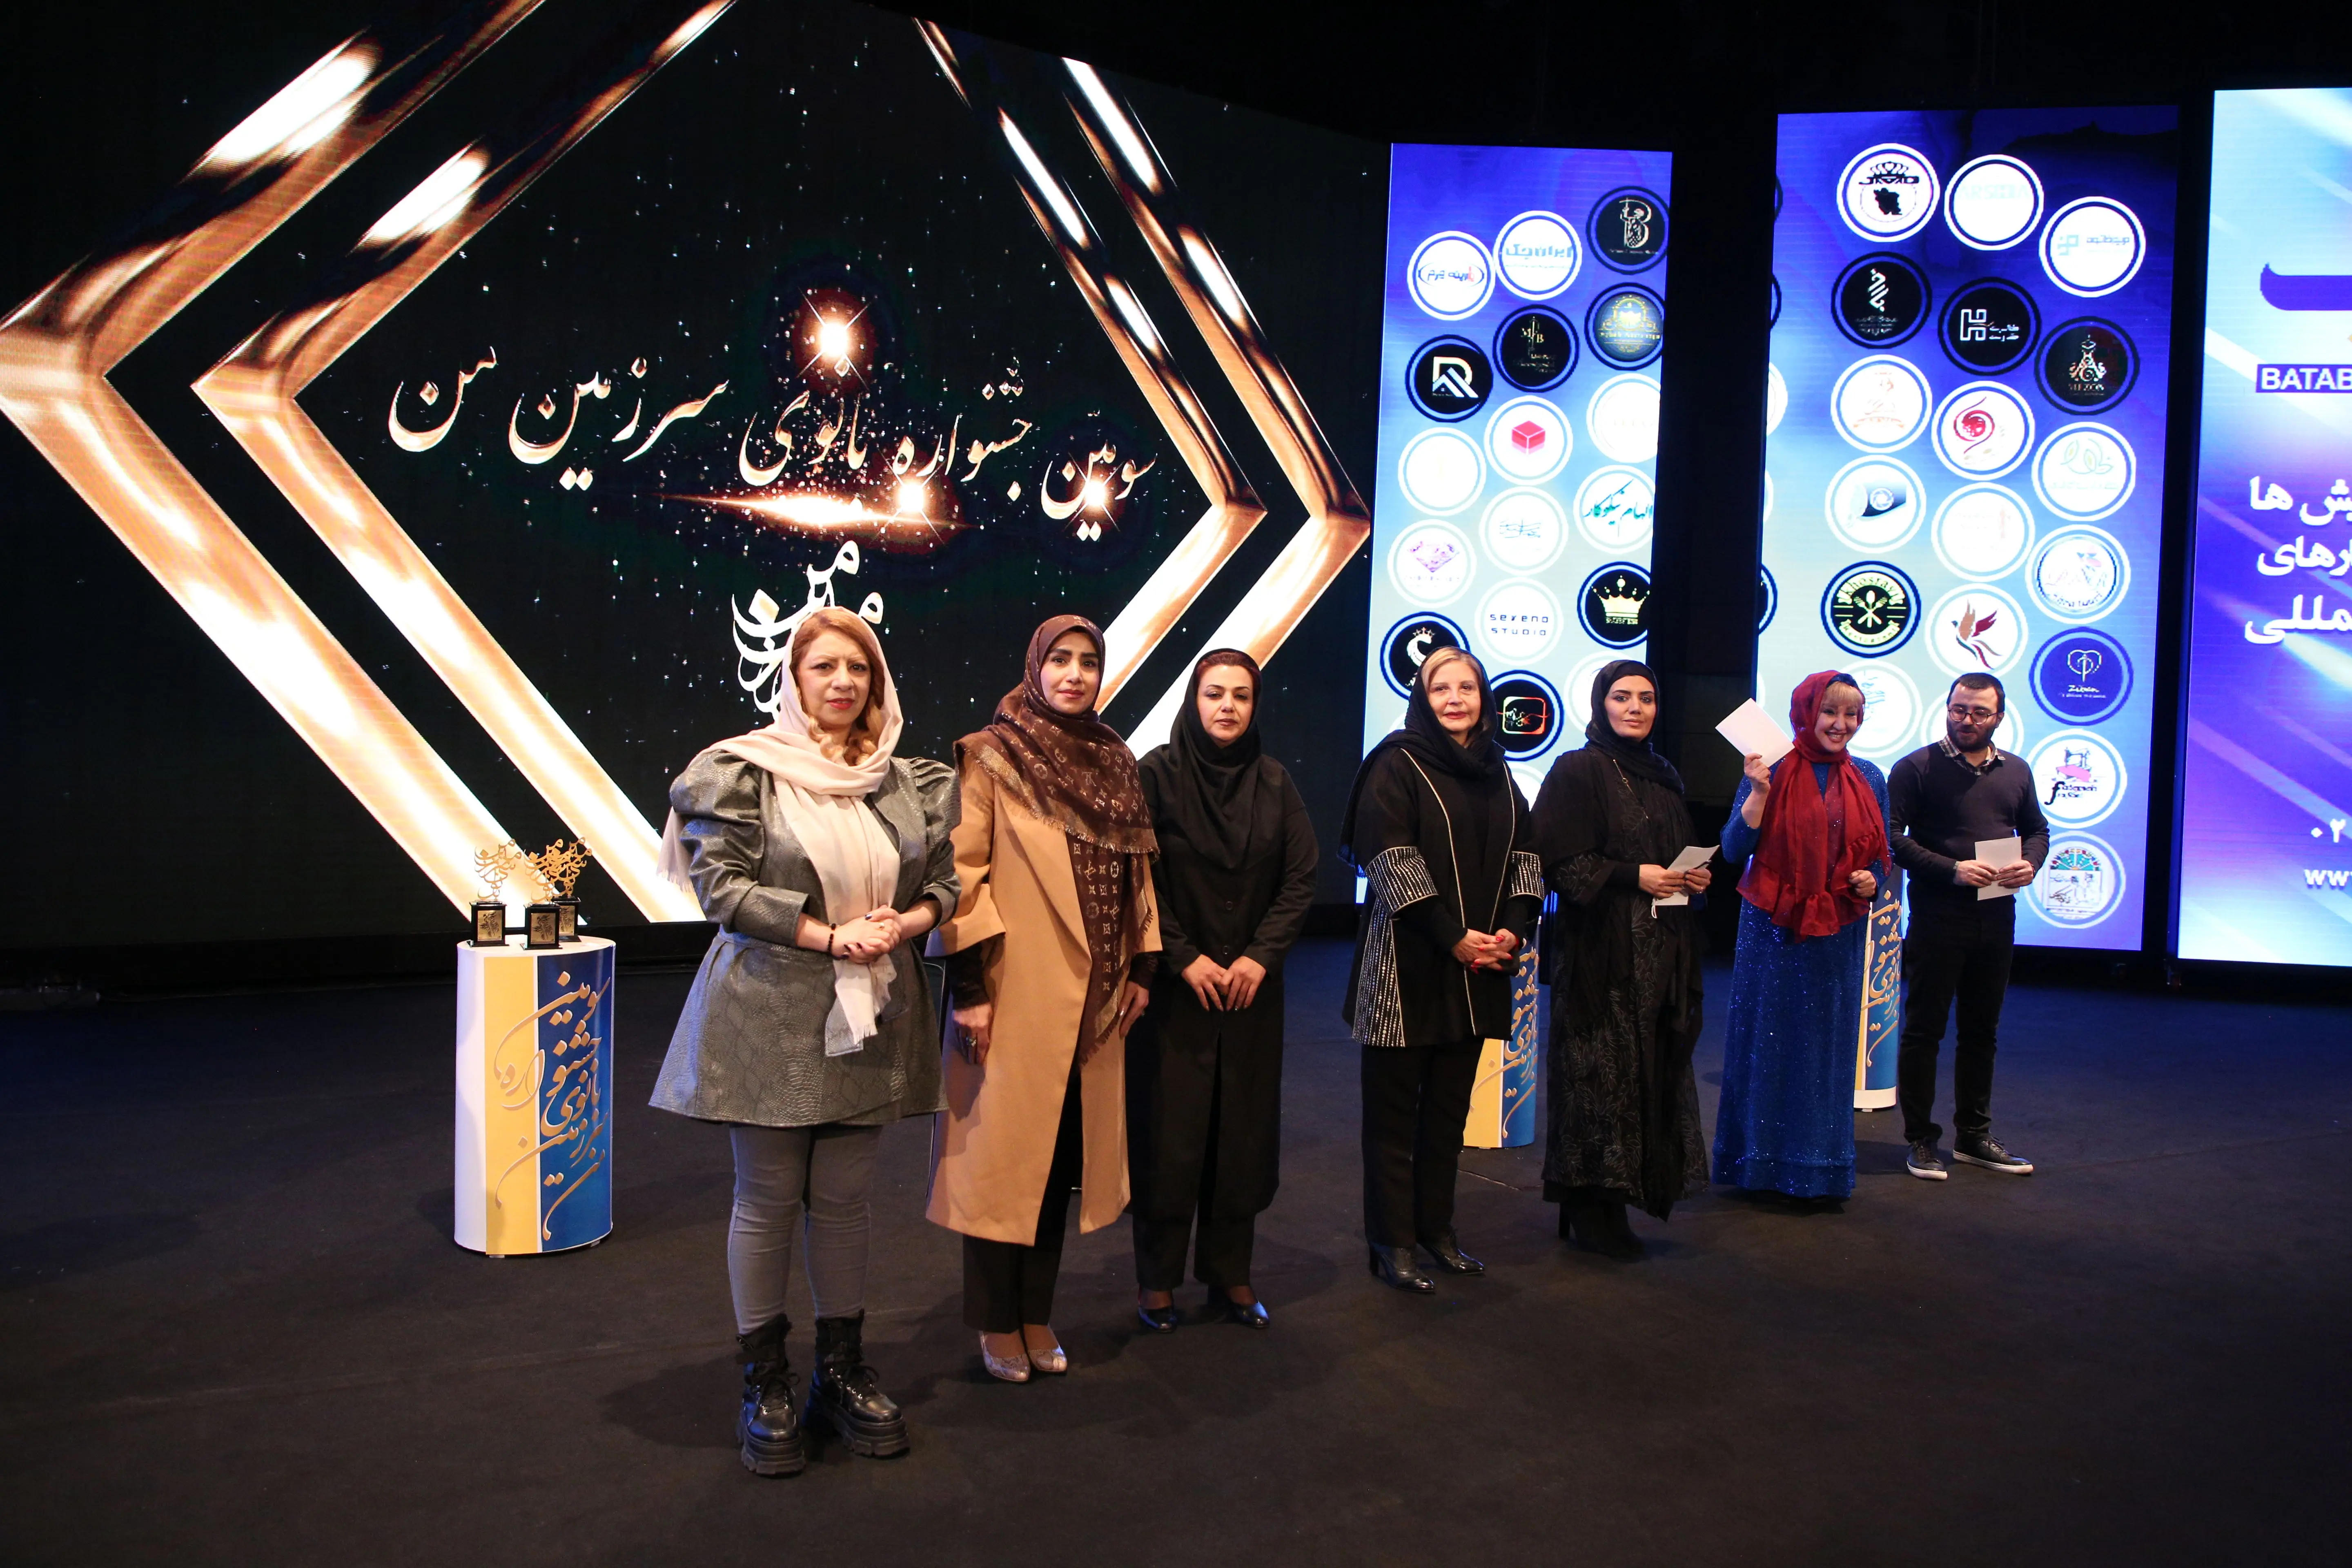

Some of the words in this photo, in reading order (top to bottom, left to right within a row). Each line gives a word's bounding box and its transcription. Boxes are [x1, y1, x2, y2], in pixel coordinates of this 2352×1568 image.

[388, 346, 497, 452] من
[509, 356, 728, 490] سرزمین
[2250, 476, 2293, 510] ها
